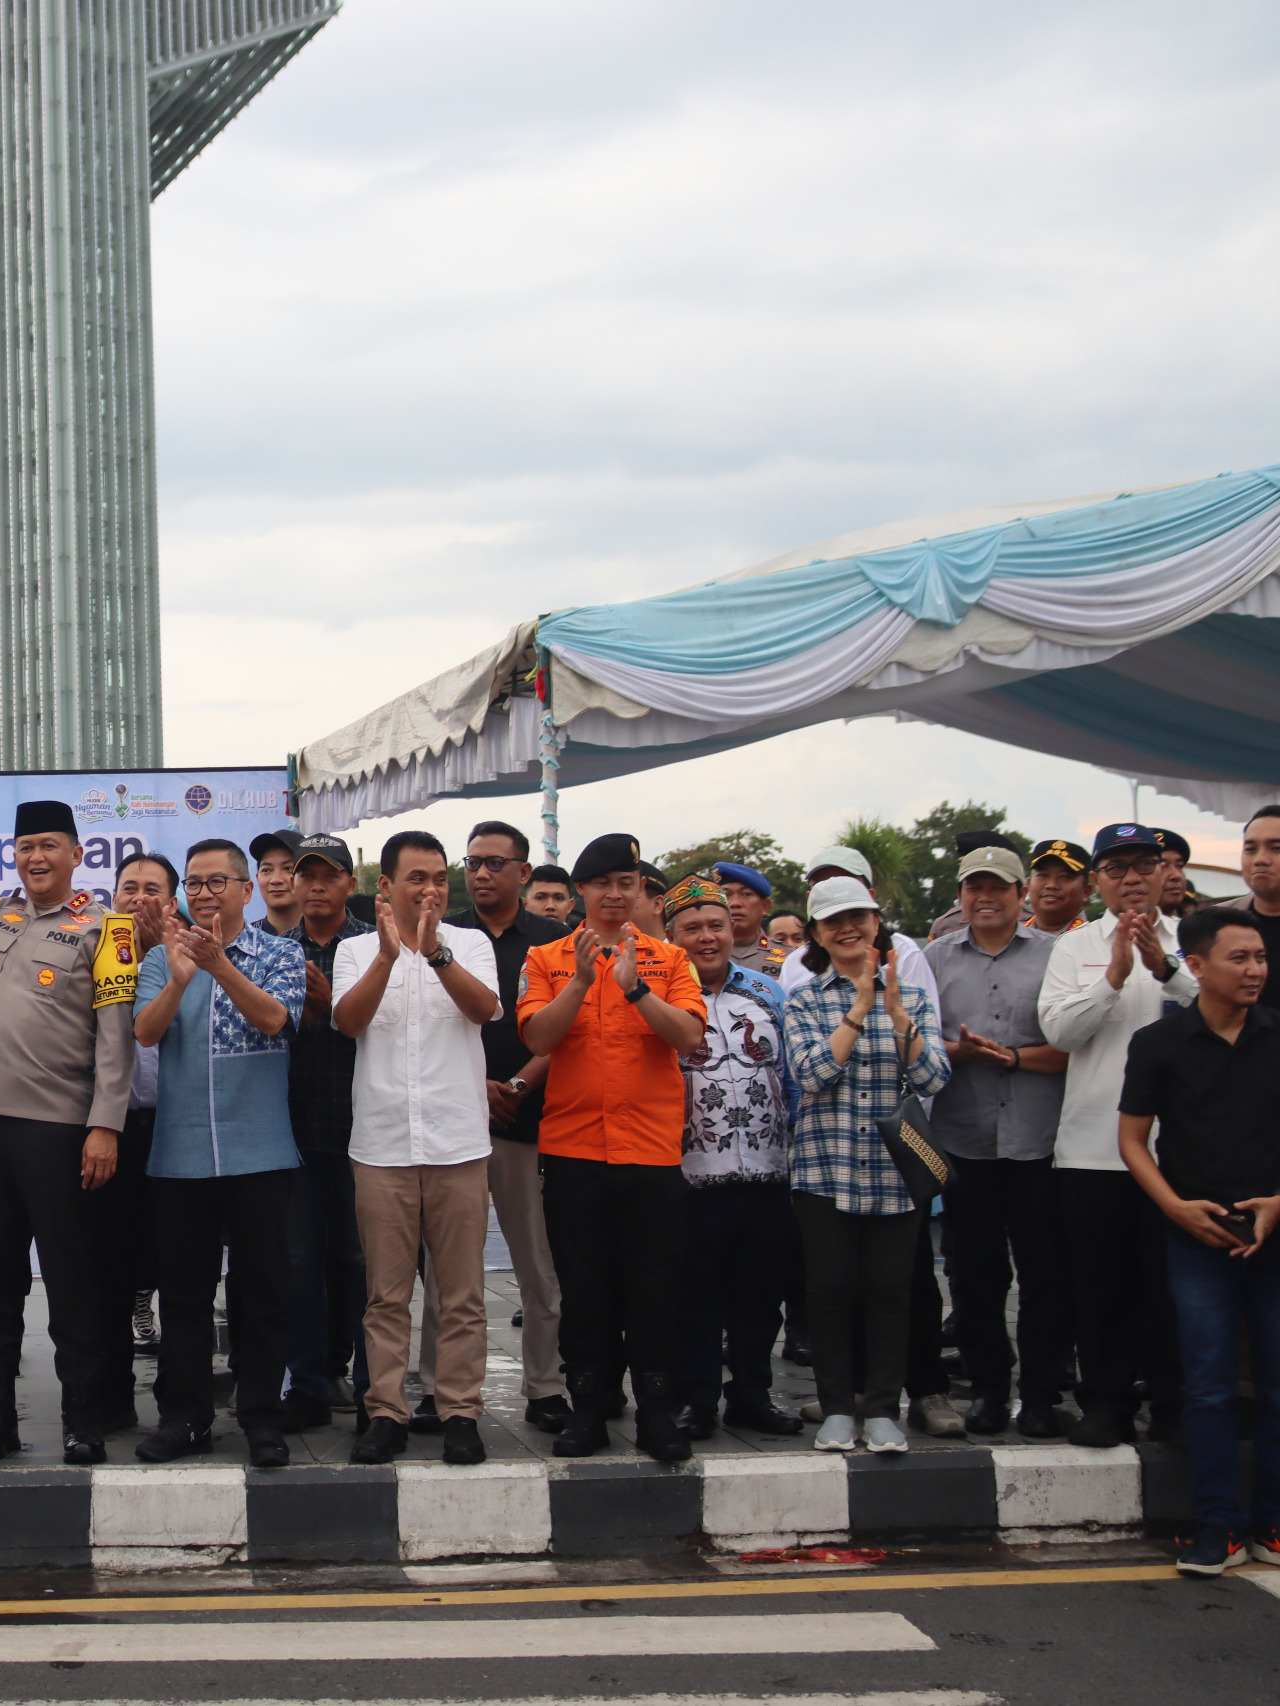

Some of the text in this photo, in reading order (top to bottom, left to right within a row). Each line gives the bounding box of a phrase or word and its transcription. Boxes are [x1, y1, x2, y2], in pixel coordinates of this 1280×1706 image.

[75, 803, 111, 813] Nyaman
[46, 931, 80, 947] POLRI
[96, 989, 120, 1001] KETUPAT
